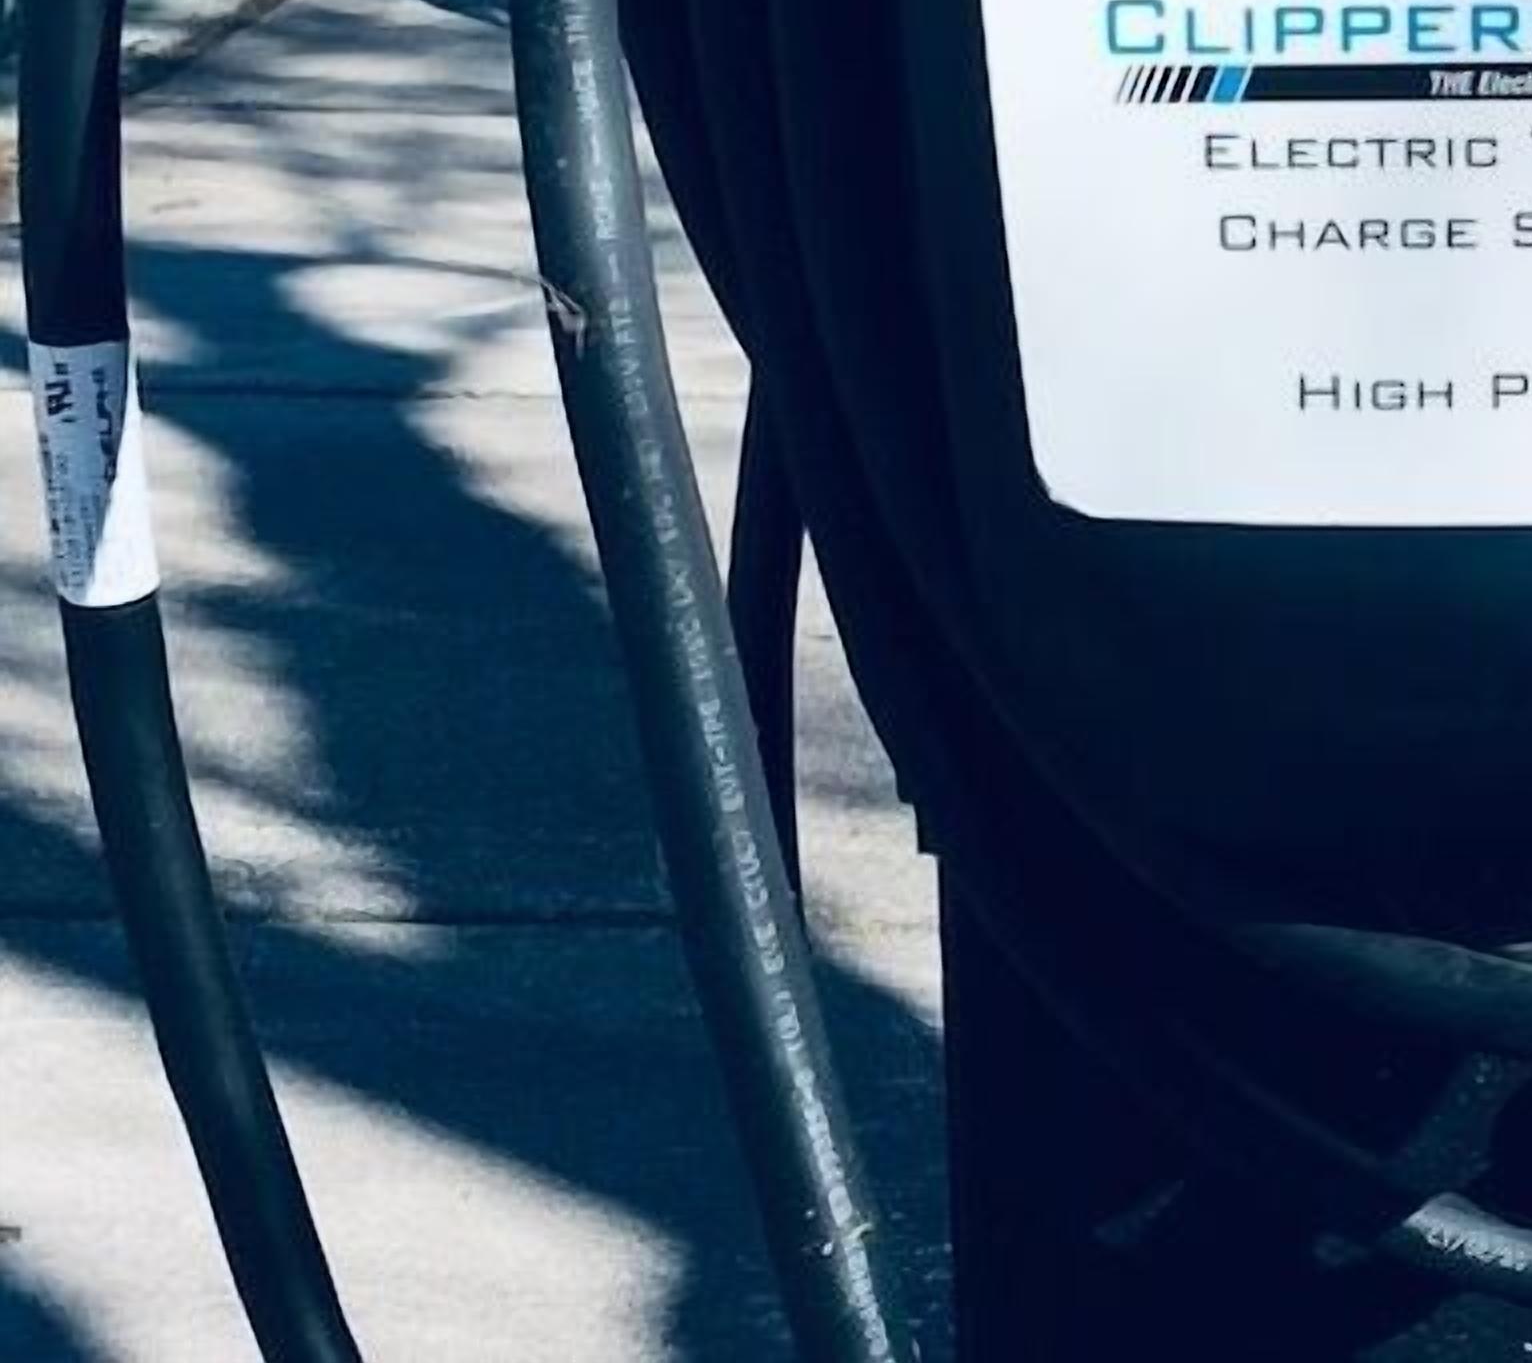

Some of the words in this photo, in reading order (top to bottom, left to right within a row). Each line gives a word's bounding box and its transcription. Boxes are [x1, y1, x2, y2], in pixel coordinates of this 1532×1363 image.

[1430, 71, 1474, 95] THE
[1204, 133, 1499, 169] ELECTRIC
[1219, 213, 1478, 251] CHARGE
[1298, 374, 1454, 411] HIGH
